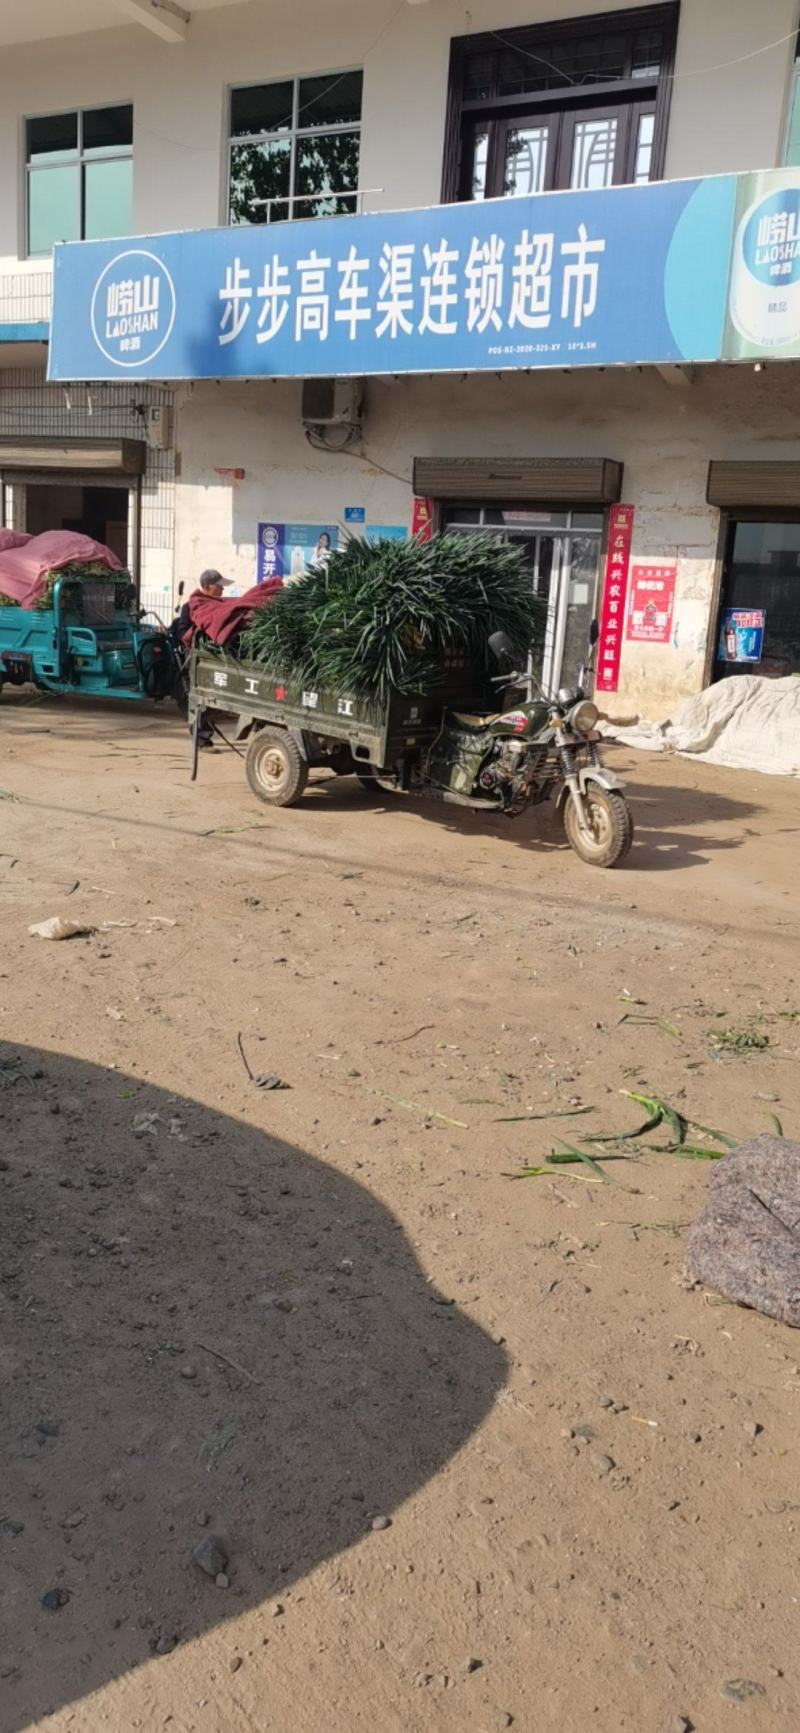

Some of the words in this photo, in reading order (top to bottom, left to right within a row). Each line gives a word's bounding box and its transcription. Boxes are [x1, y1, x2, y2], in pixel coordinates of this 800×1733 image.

[106, 275, 160, 318] 崂山
[218, 223, 605, 346] 步步高车渠连锁超市
[105, 311, 159, 339] LAOSHAN
[213, 671, 259, 696] 军工
